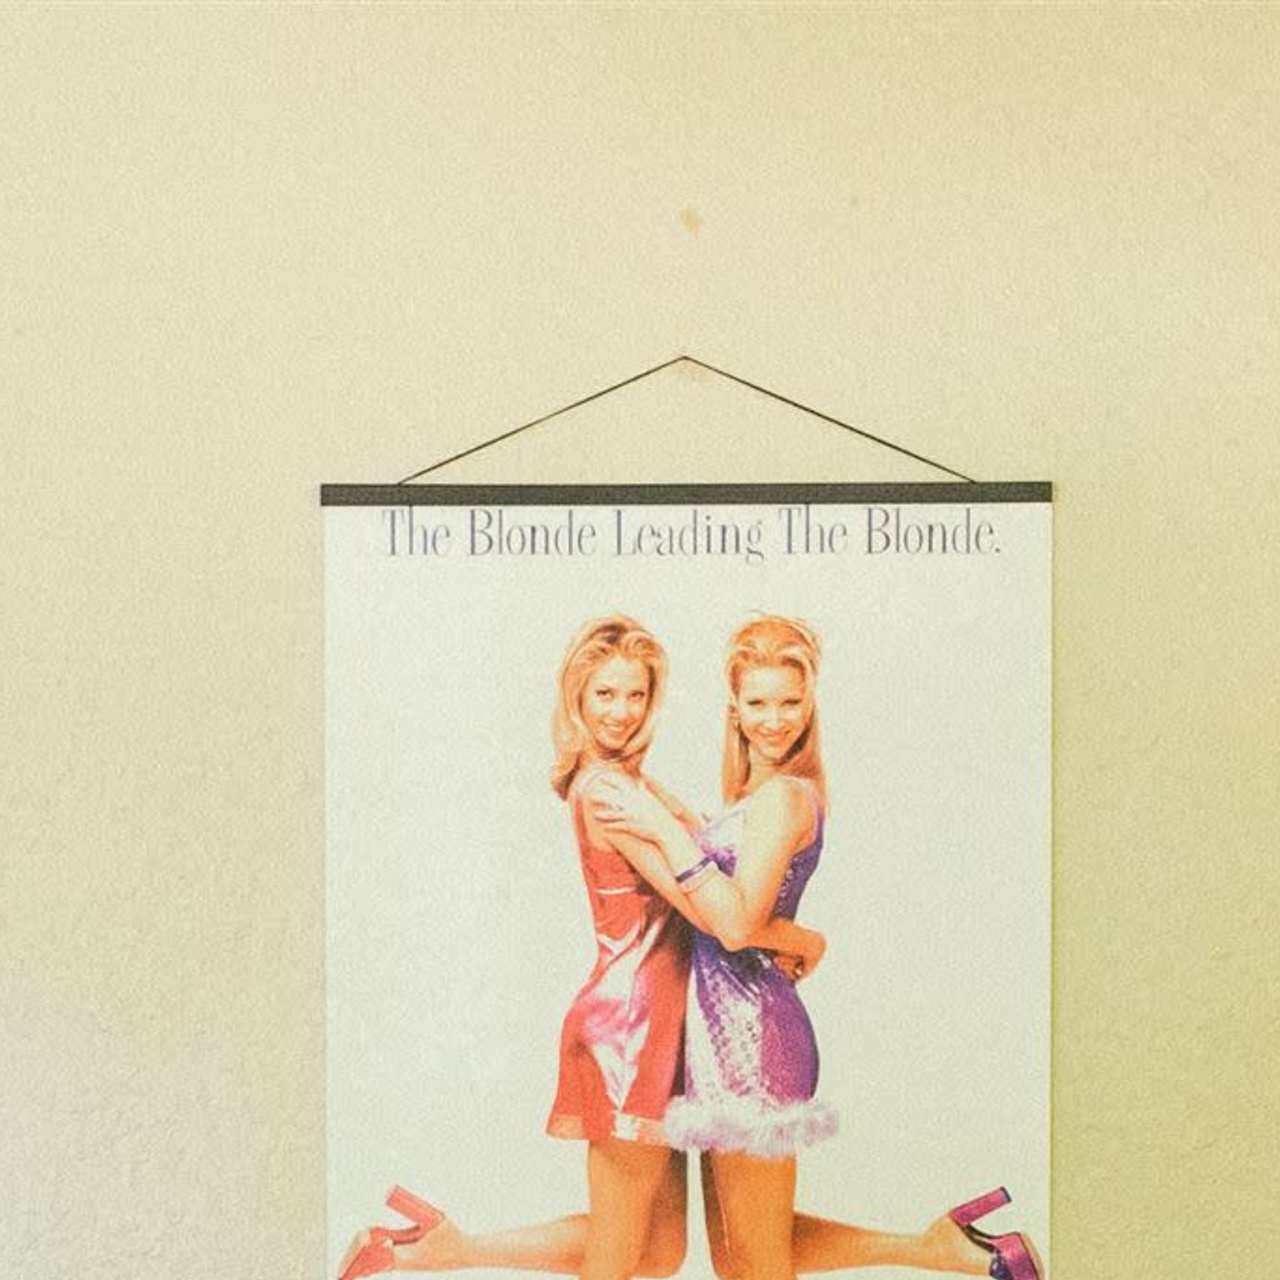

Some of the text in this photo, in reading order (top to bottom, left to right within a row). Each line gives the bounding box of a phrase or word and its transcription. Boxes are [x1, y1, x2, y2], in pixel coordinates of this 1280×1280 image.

[382, 504, 1002, 566] The Blonde Leading The Blonde.
